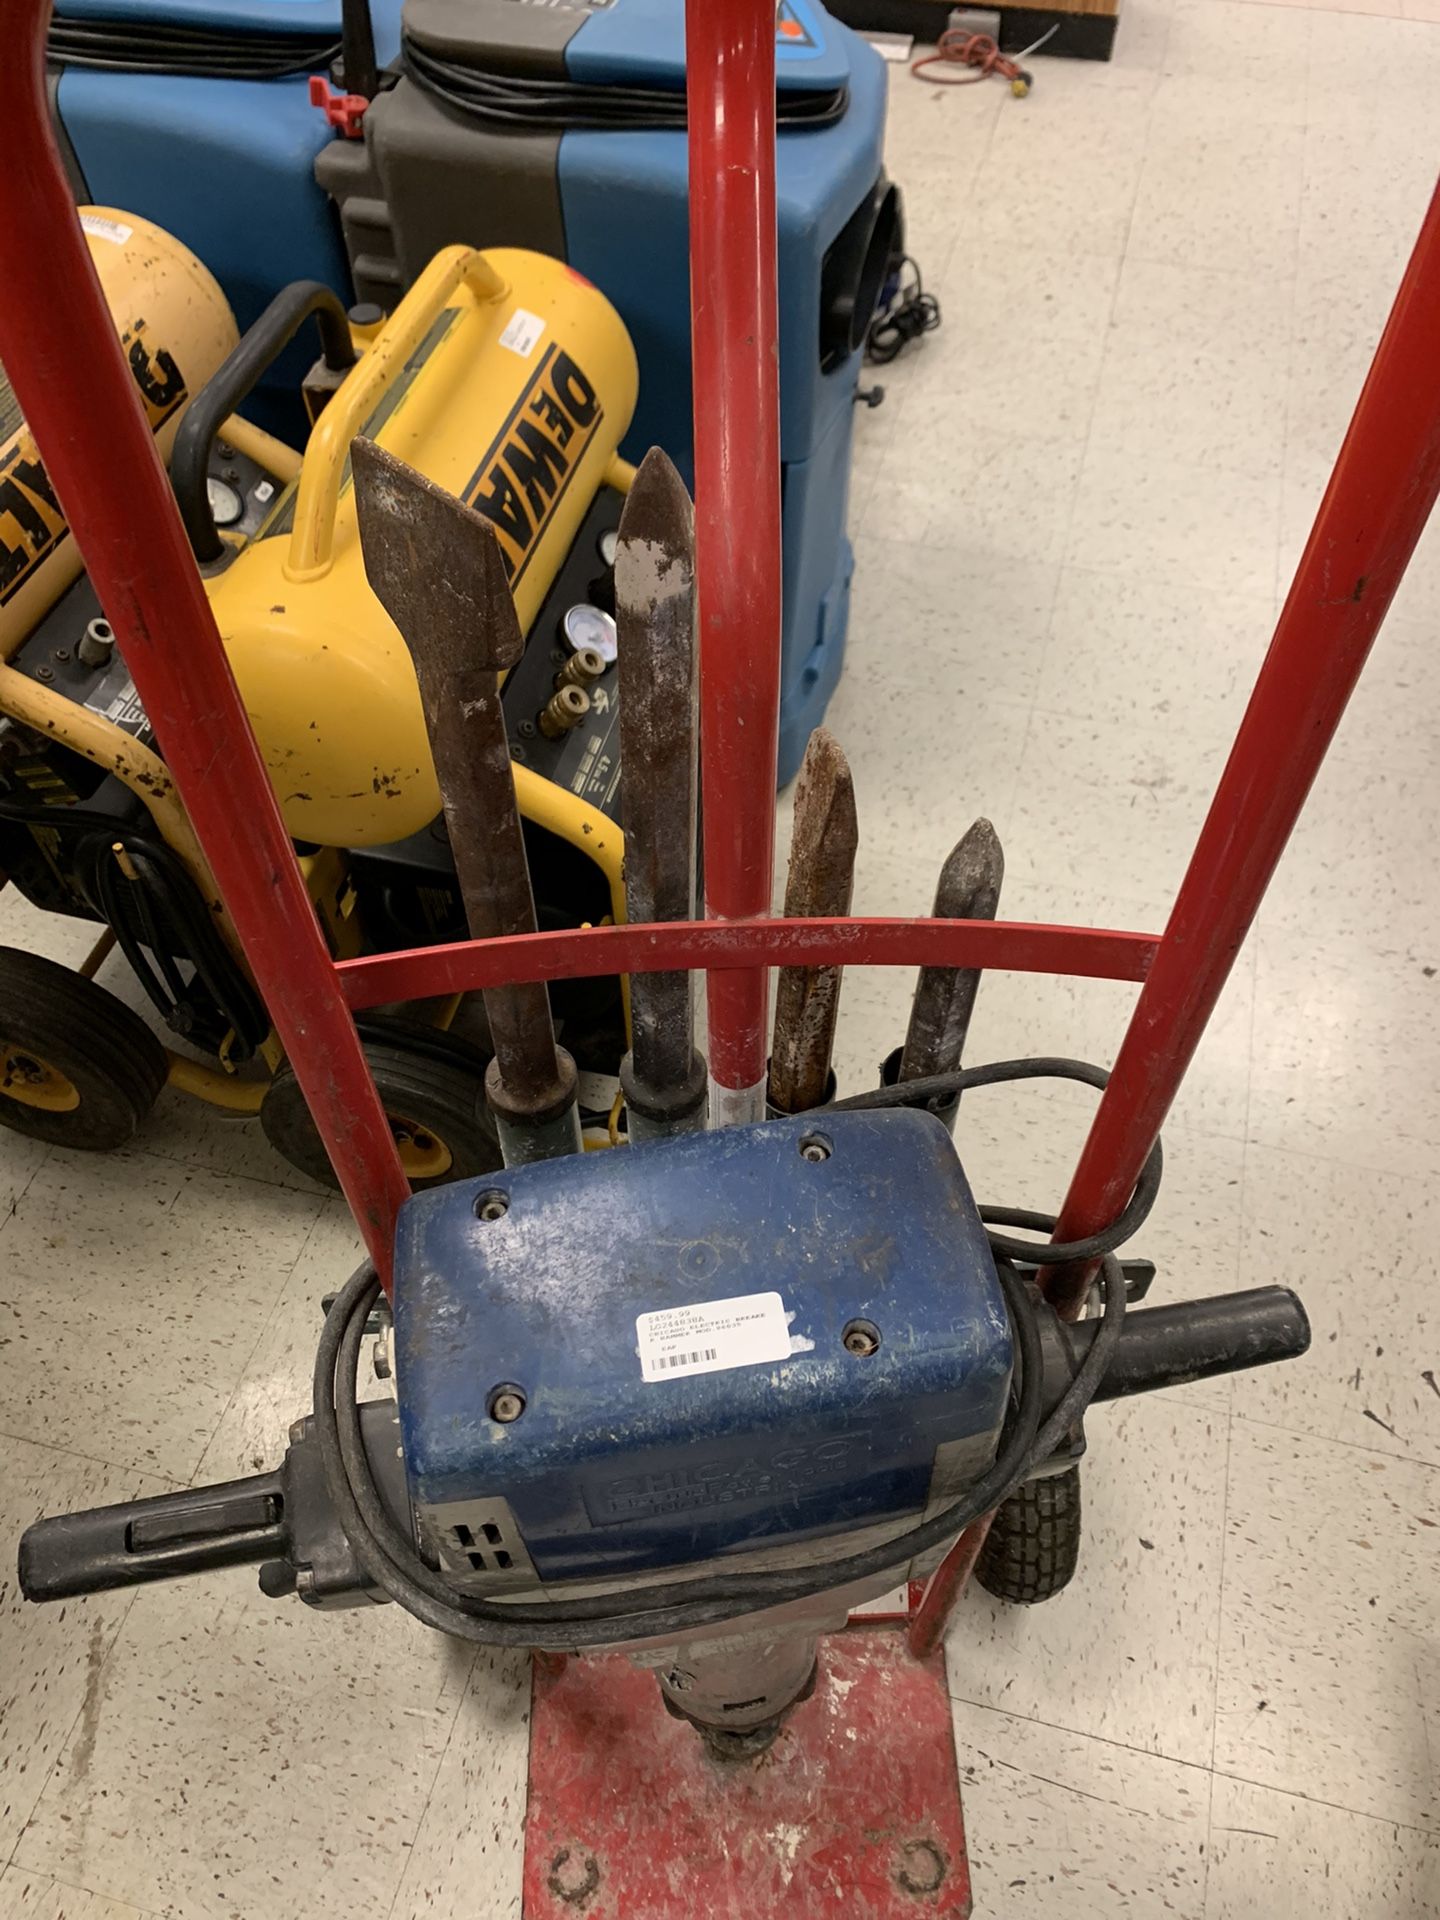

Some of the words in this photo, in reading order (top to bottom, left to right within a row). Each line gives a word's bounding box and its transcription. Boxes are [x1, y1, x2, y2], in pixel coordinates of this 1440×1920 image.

[472, 350, 598, 580] DEWA
[648, 1327, 685, 1338] CHICAGO
[689, 1318, 730, 1330] ELECTRIC
[608, 1440, 852, 1498] CHICAGO
